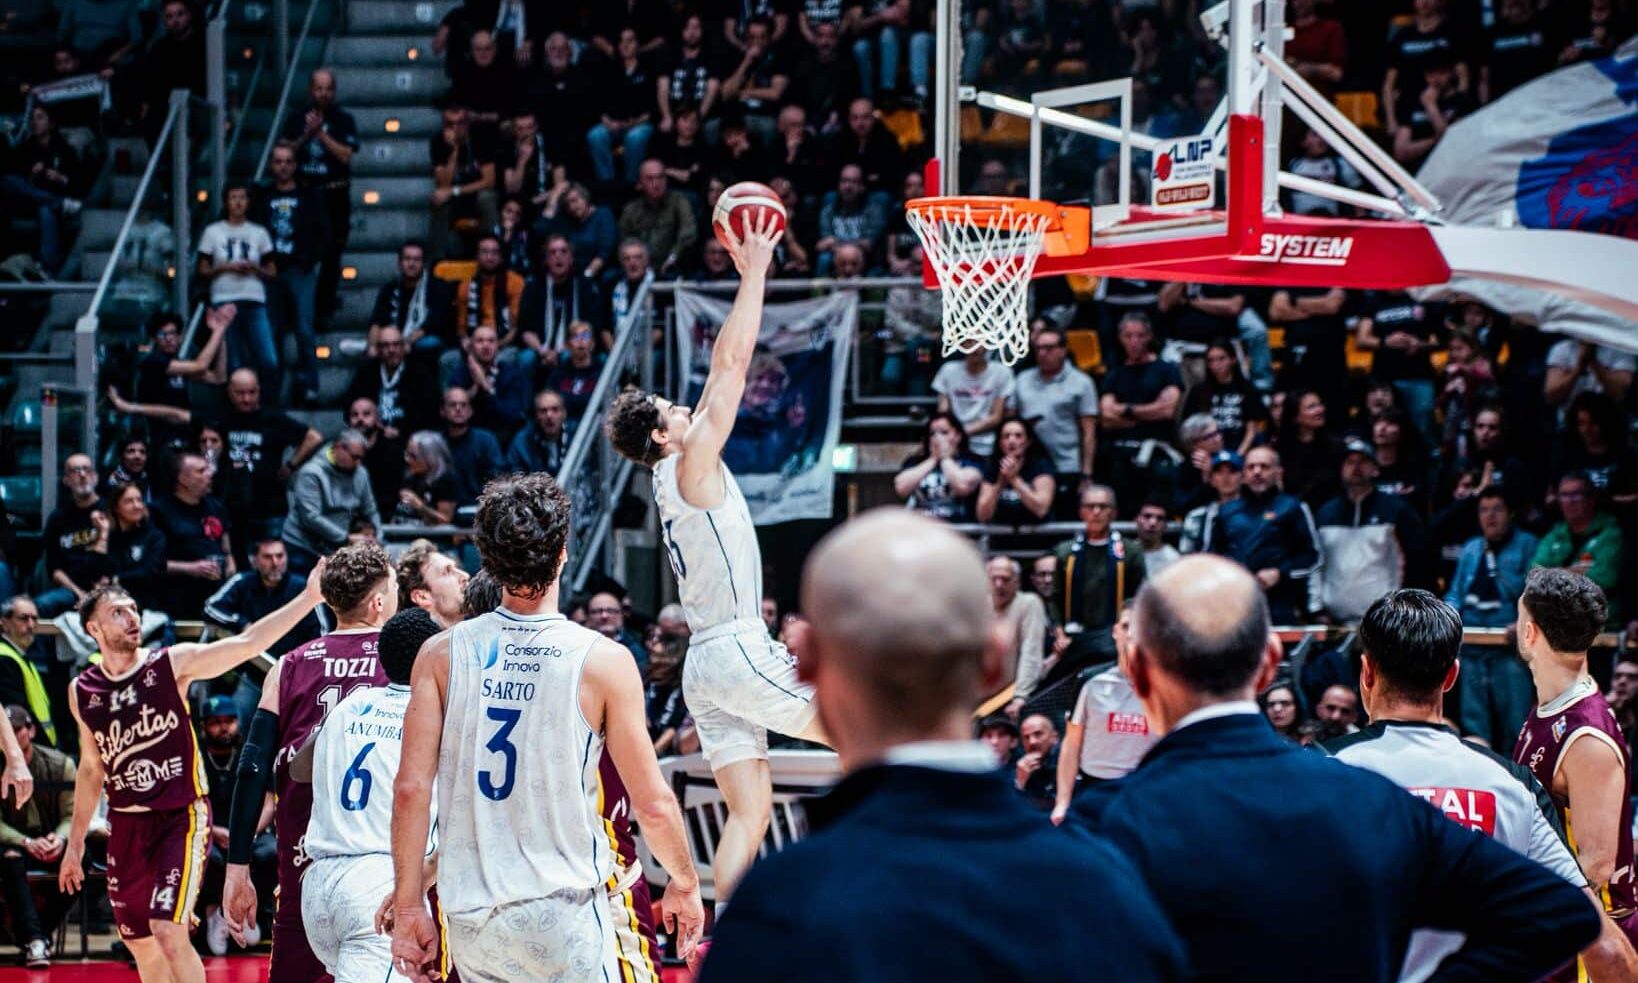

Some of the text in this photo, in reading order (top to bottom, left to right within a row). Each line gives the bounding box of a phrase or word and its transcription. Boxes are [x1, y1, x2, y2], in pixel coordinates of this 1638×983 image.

[1173, 139, 1212, 163] LNP
[1260, 233, 1354, 260] SYSTEM
[504, 644, 562, 658] Consorzio
[323, 658, 377, 678] TOZZI
[503, 659, 541, 672] Innova
[109, 683, 138, 712] 14
[482, 678, 535, 701] SARTO
[95, 703, 179, 766] Libertas
[478, 706, 522, 801] 3
[341, 742, 376, 811] 6
[150, 885, 176, 911] 14
